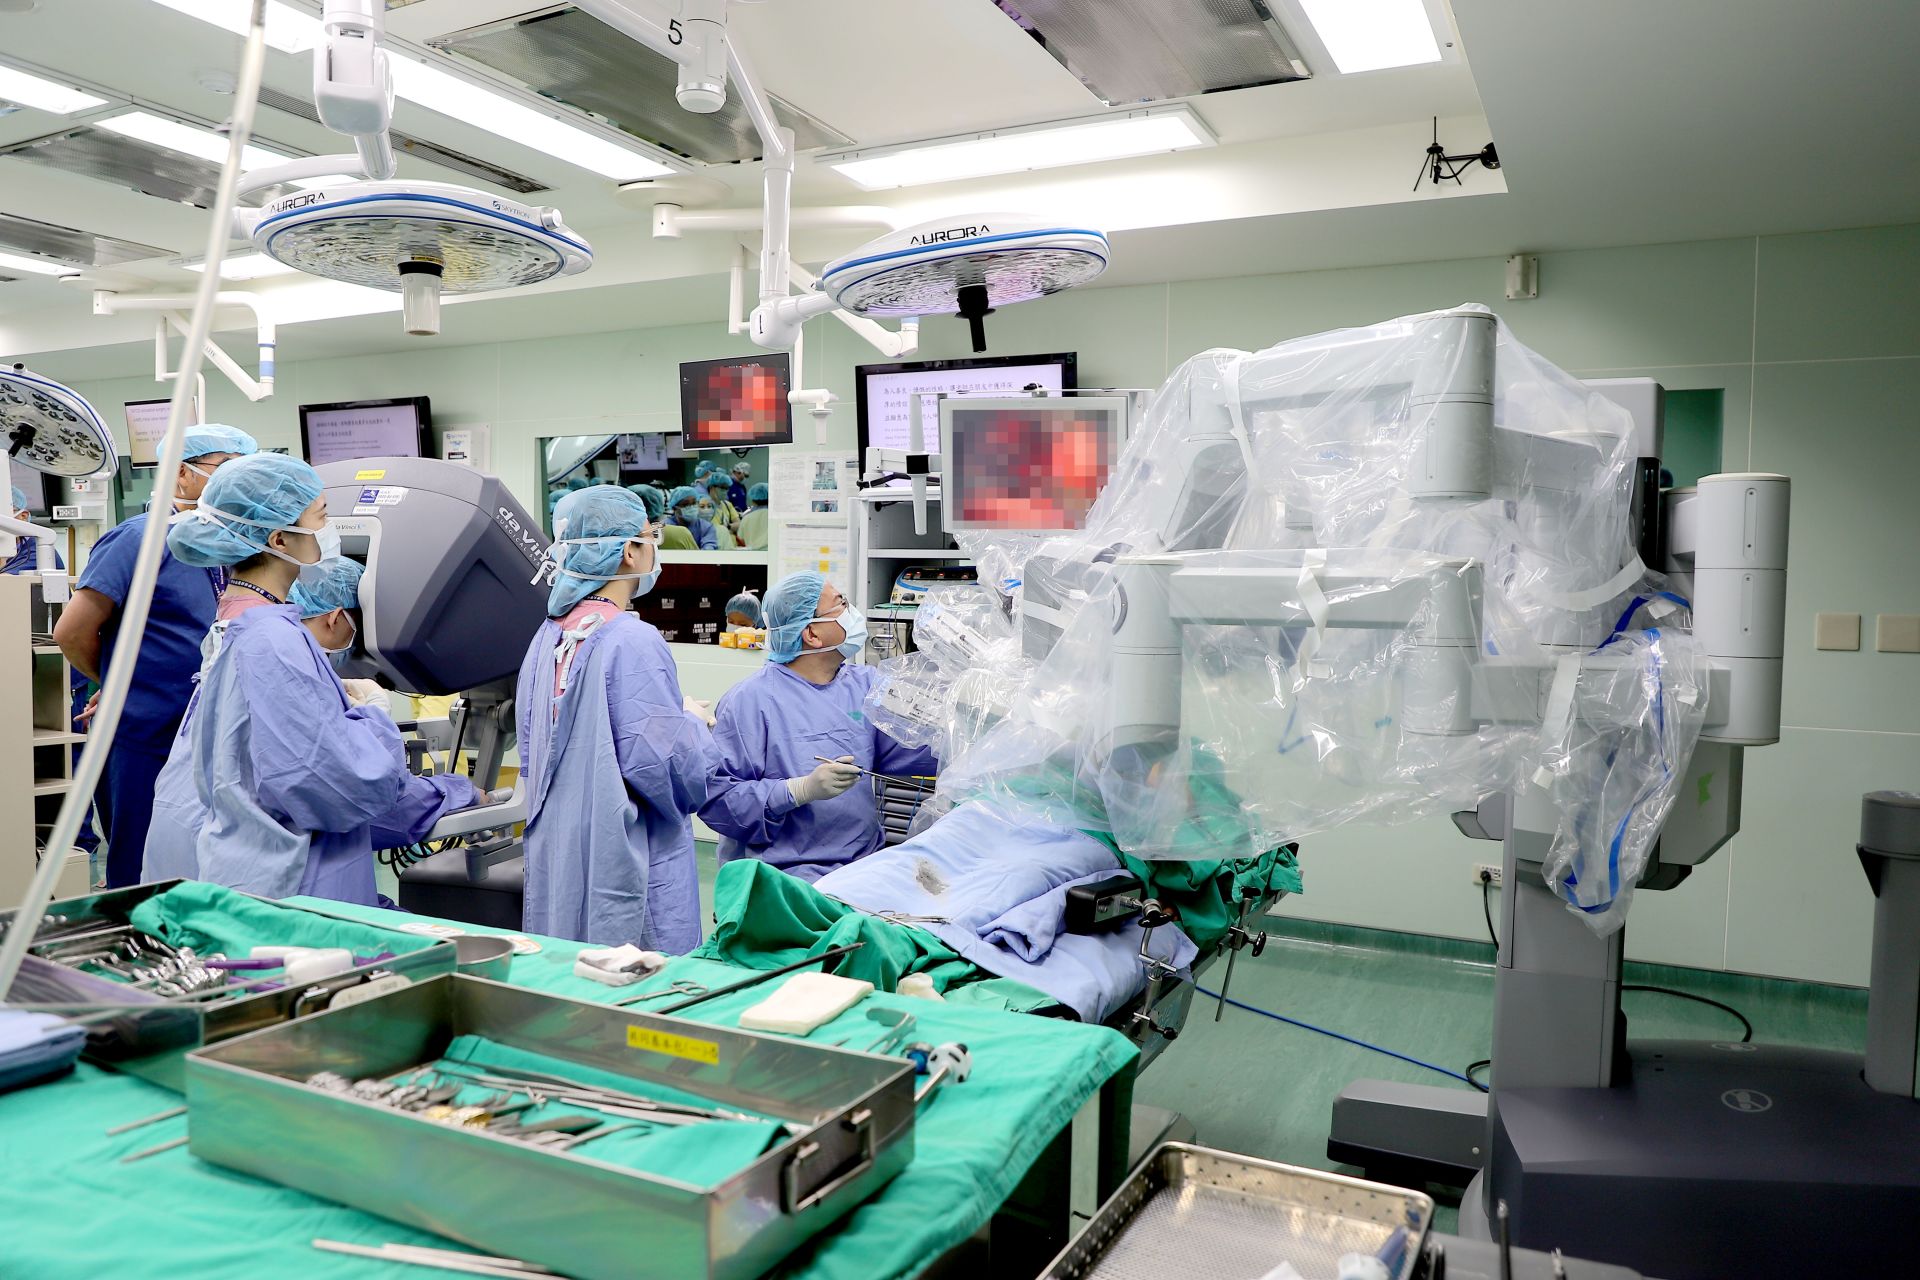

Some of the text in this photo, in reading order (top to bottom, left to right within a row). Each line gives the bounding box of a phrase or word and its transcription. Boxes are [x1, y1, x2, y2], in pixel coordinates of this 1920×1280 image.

[668, 18, 682, 45] 5
[271, 192, 325, 212] AURORA
[910, 224, 990, 245] AURORA
[1066, 353, 1074, 364] 5
[499, 506, 521, 532] da
[496, 514, 528, 551] SURGICAL
